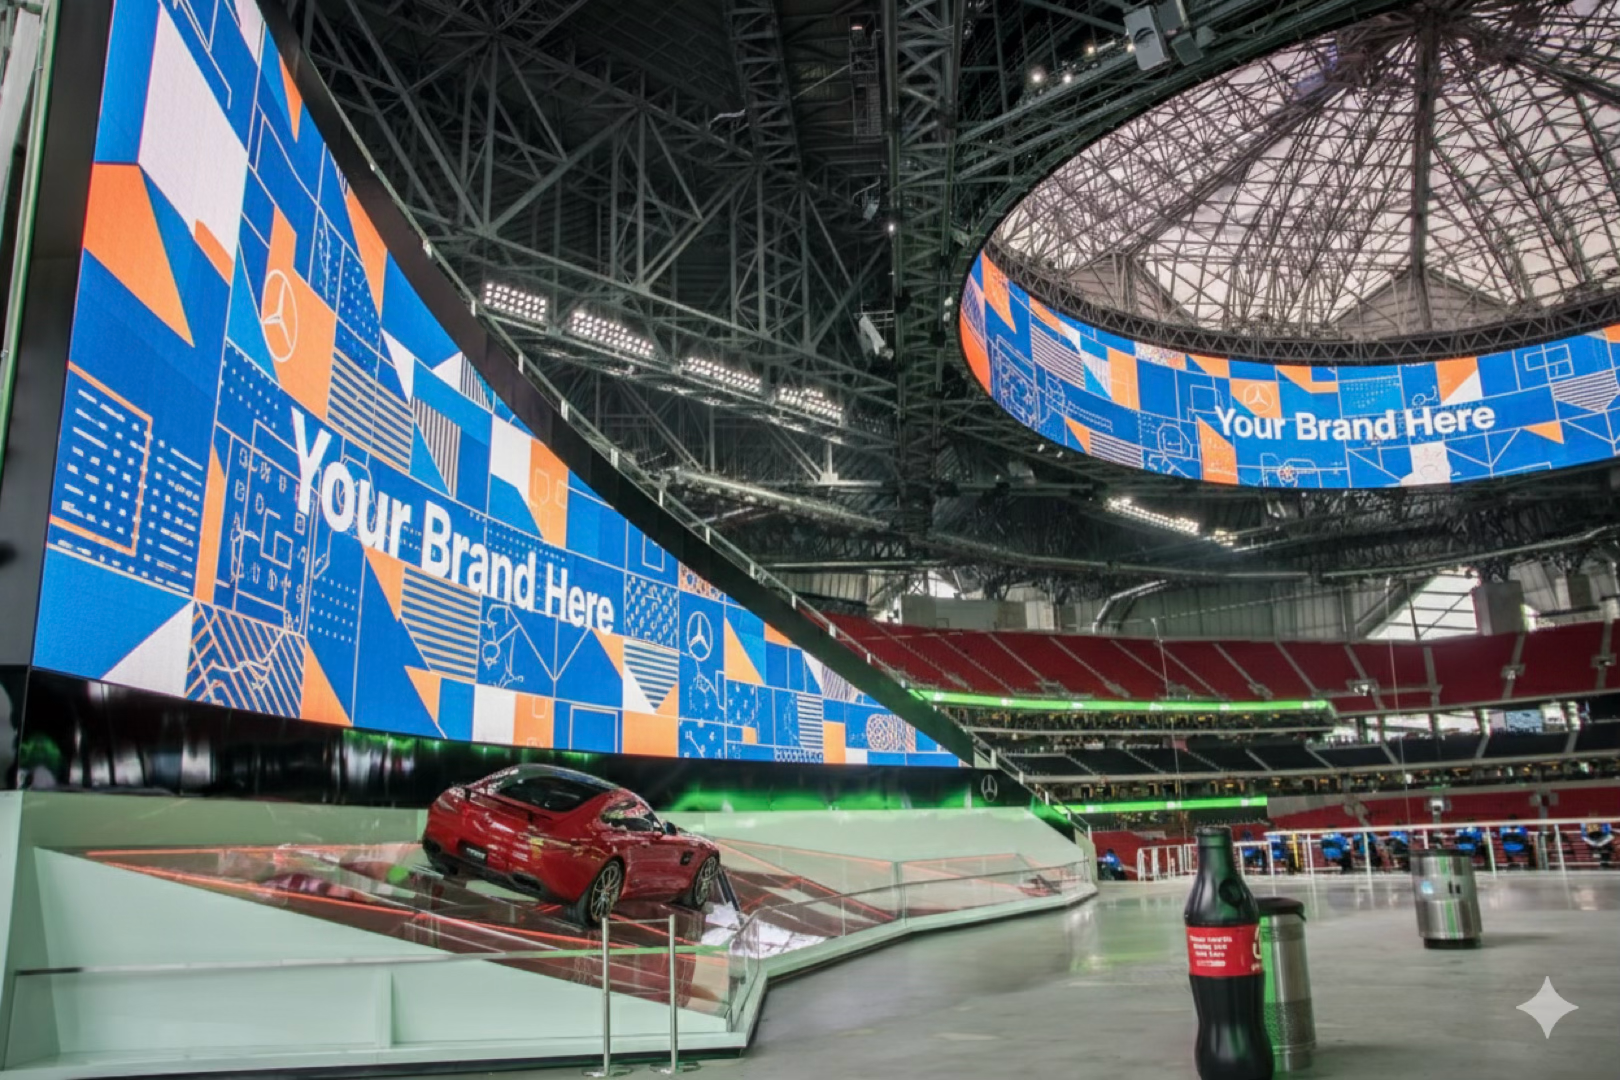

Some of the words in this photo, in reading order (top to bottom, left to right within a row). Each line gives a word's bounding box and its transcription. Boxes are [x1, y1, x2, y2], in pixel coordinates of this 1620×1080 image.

[1216, 407, 1285, 438] Your
[1296, 410, 1397, 440] Brand
[1405, 406, 1495, 436] Here
[291, 406, 411, 559] Your
[421, 500, 537, 611] Brand
[546, 563, 614, 634] Here
